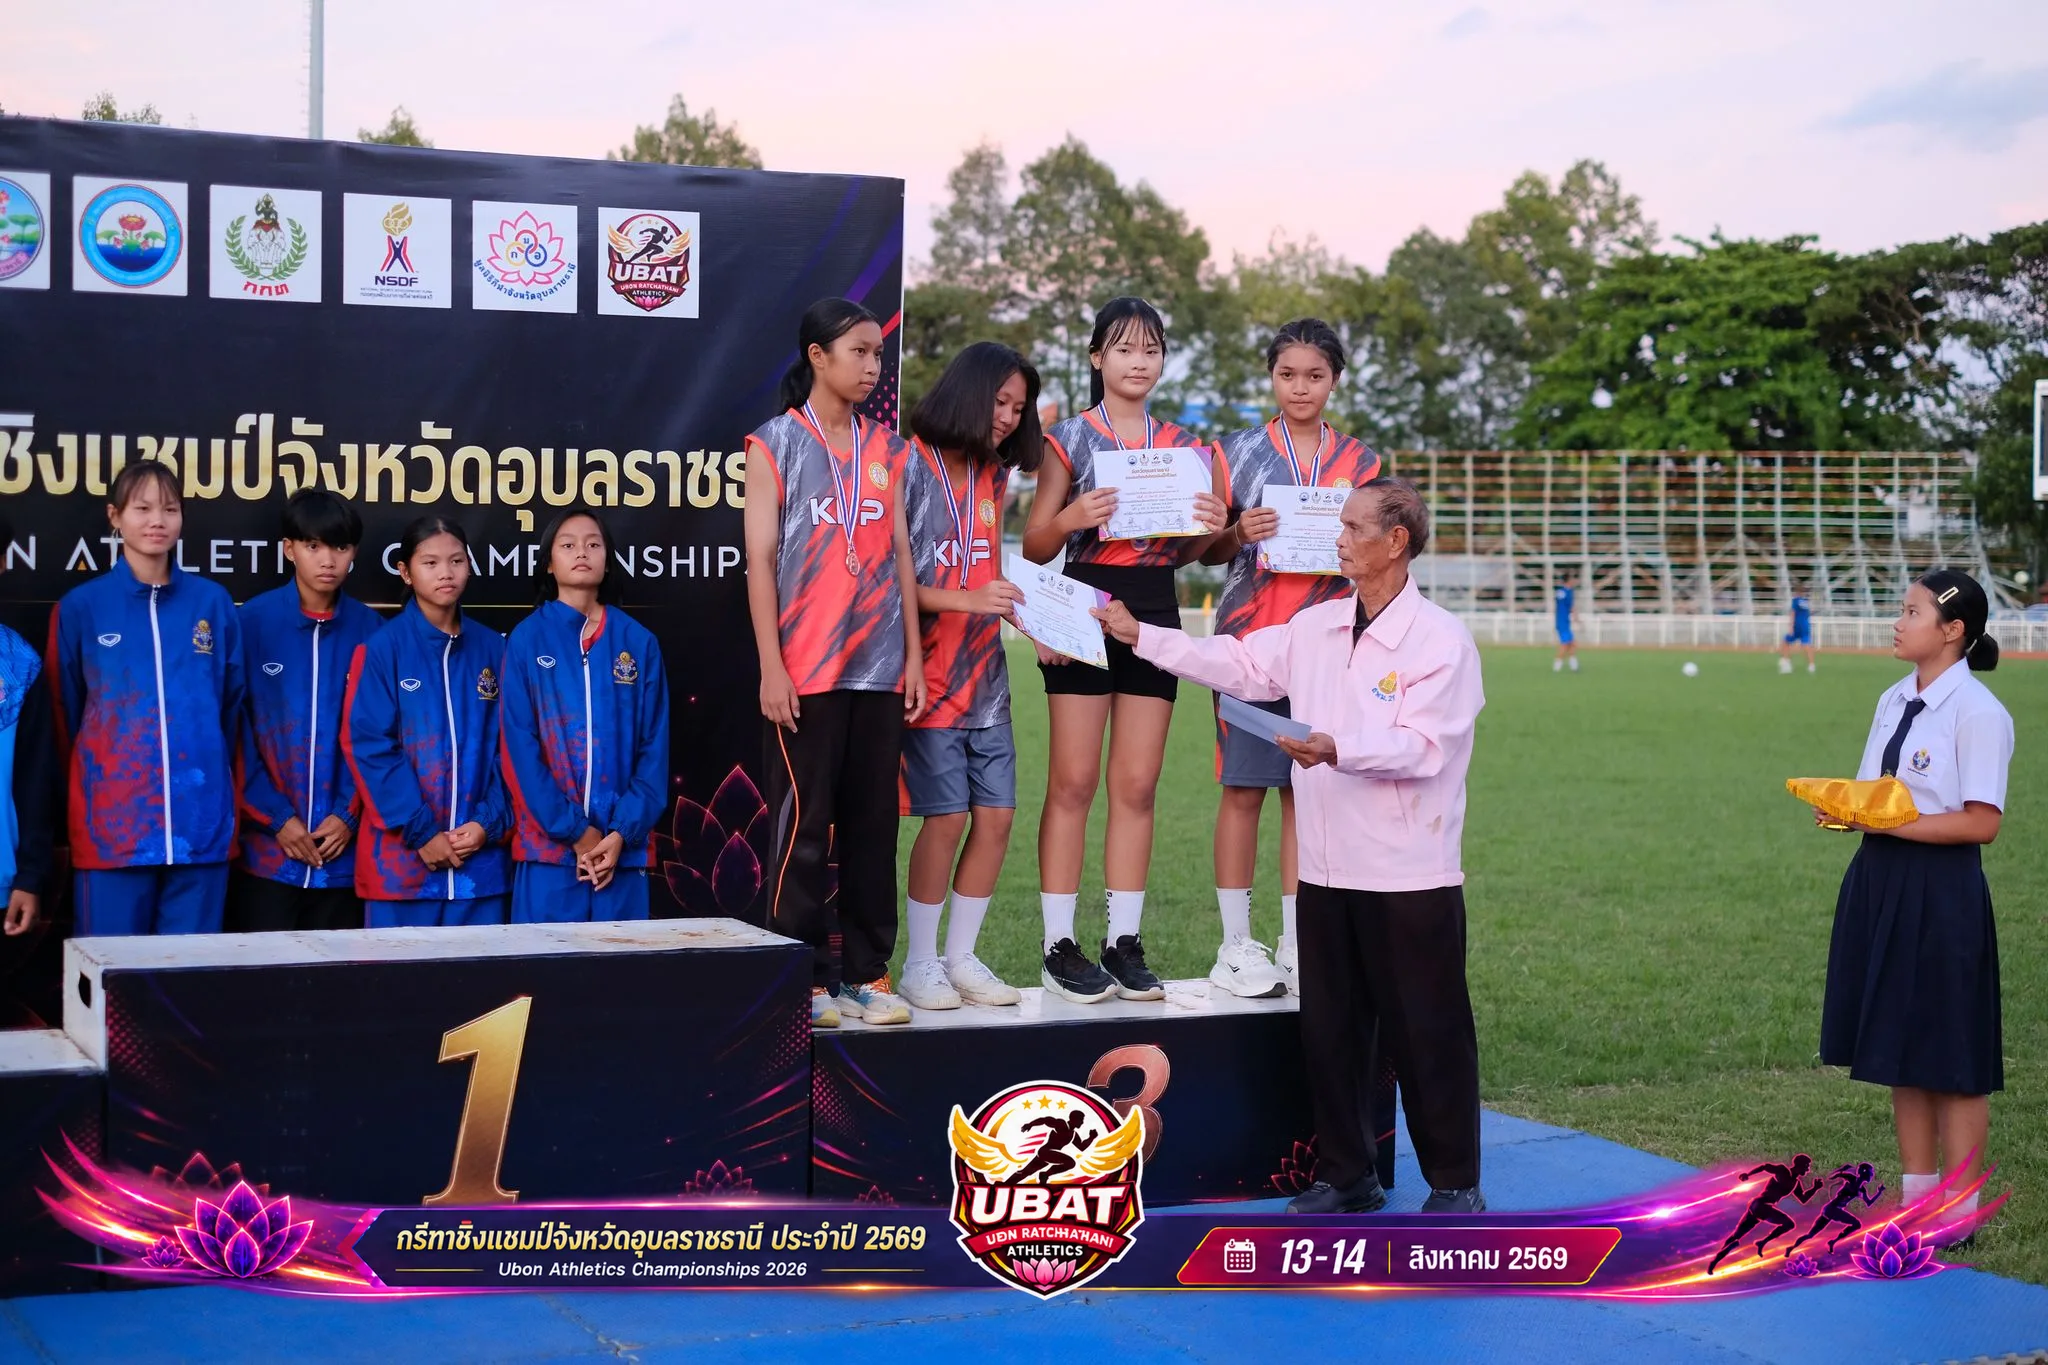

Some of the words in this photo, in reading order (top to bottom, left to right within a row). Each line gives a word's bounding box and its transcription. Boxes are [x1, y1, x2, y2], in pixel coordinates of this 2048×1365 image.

[374, 275, 419, 287] NSDF
[614, 262, 684, 284] UBAT
[243, 281, 289, 297] กกท
[422, 997, 532, 1206] 1
[1086, 1043, 1171, 1165] 3
